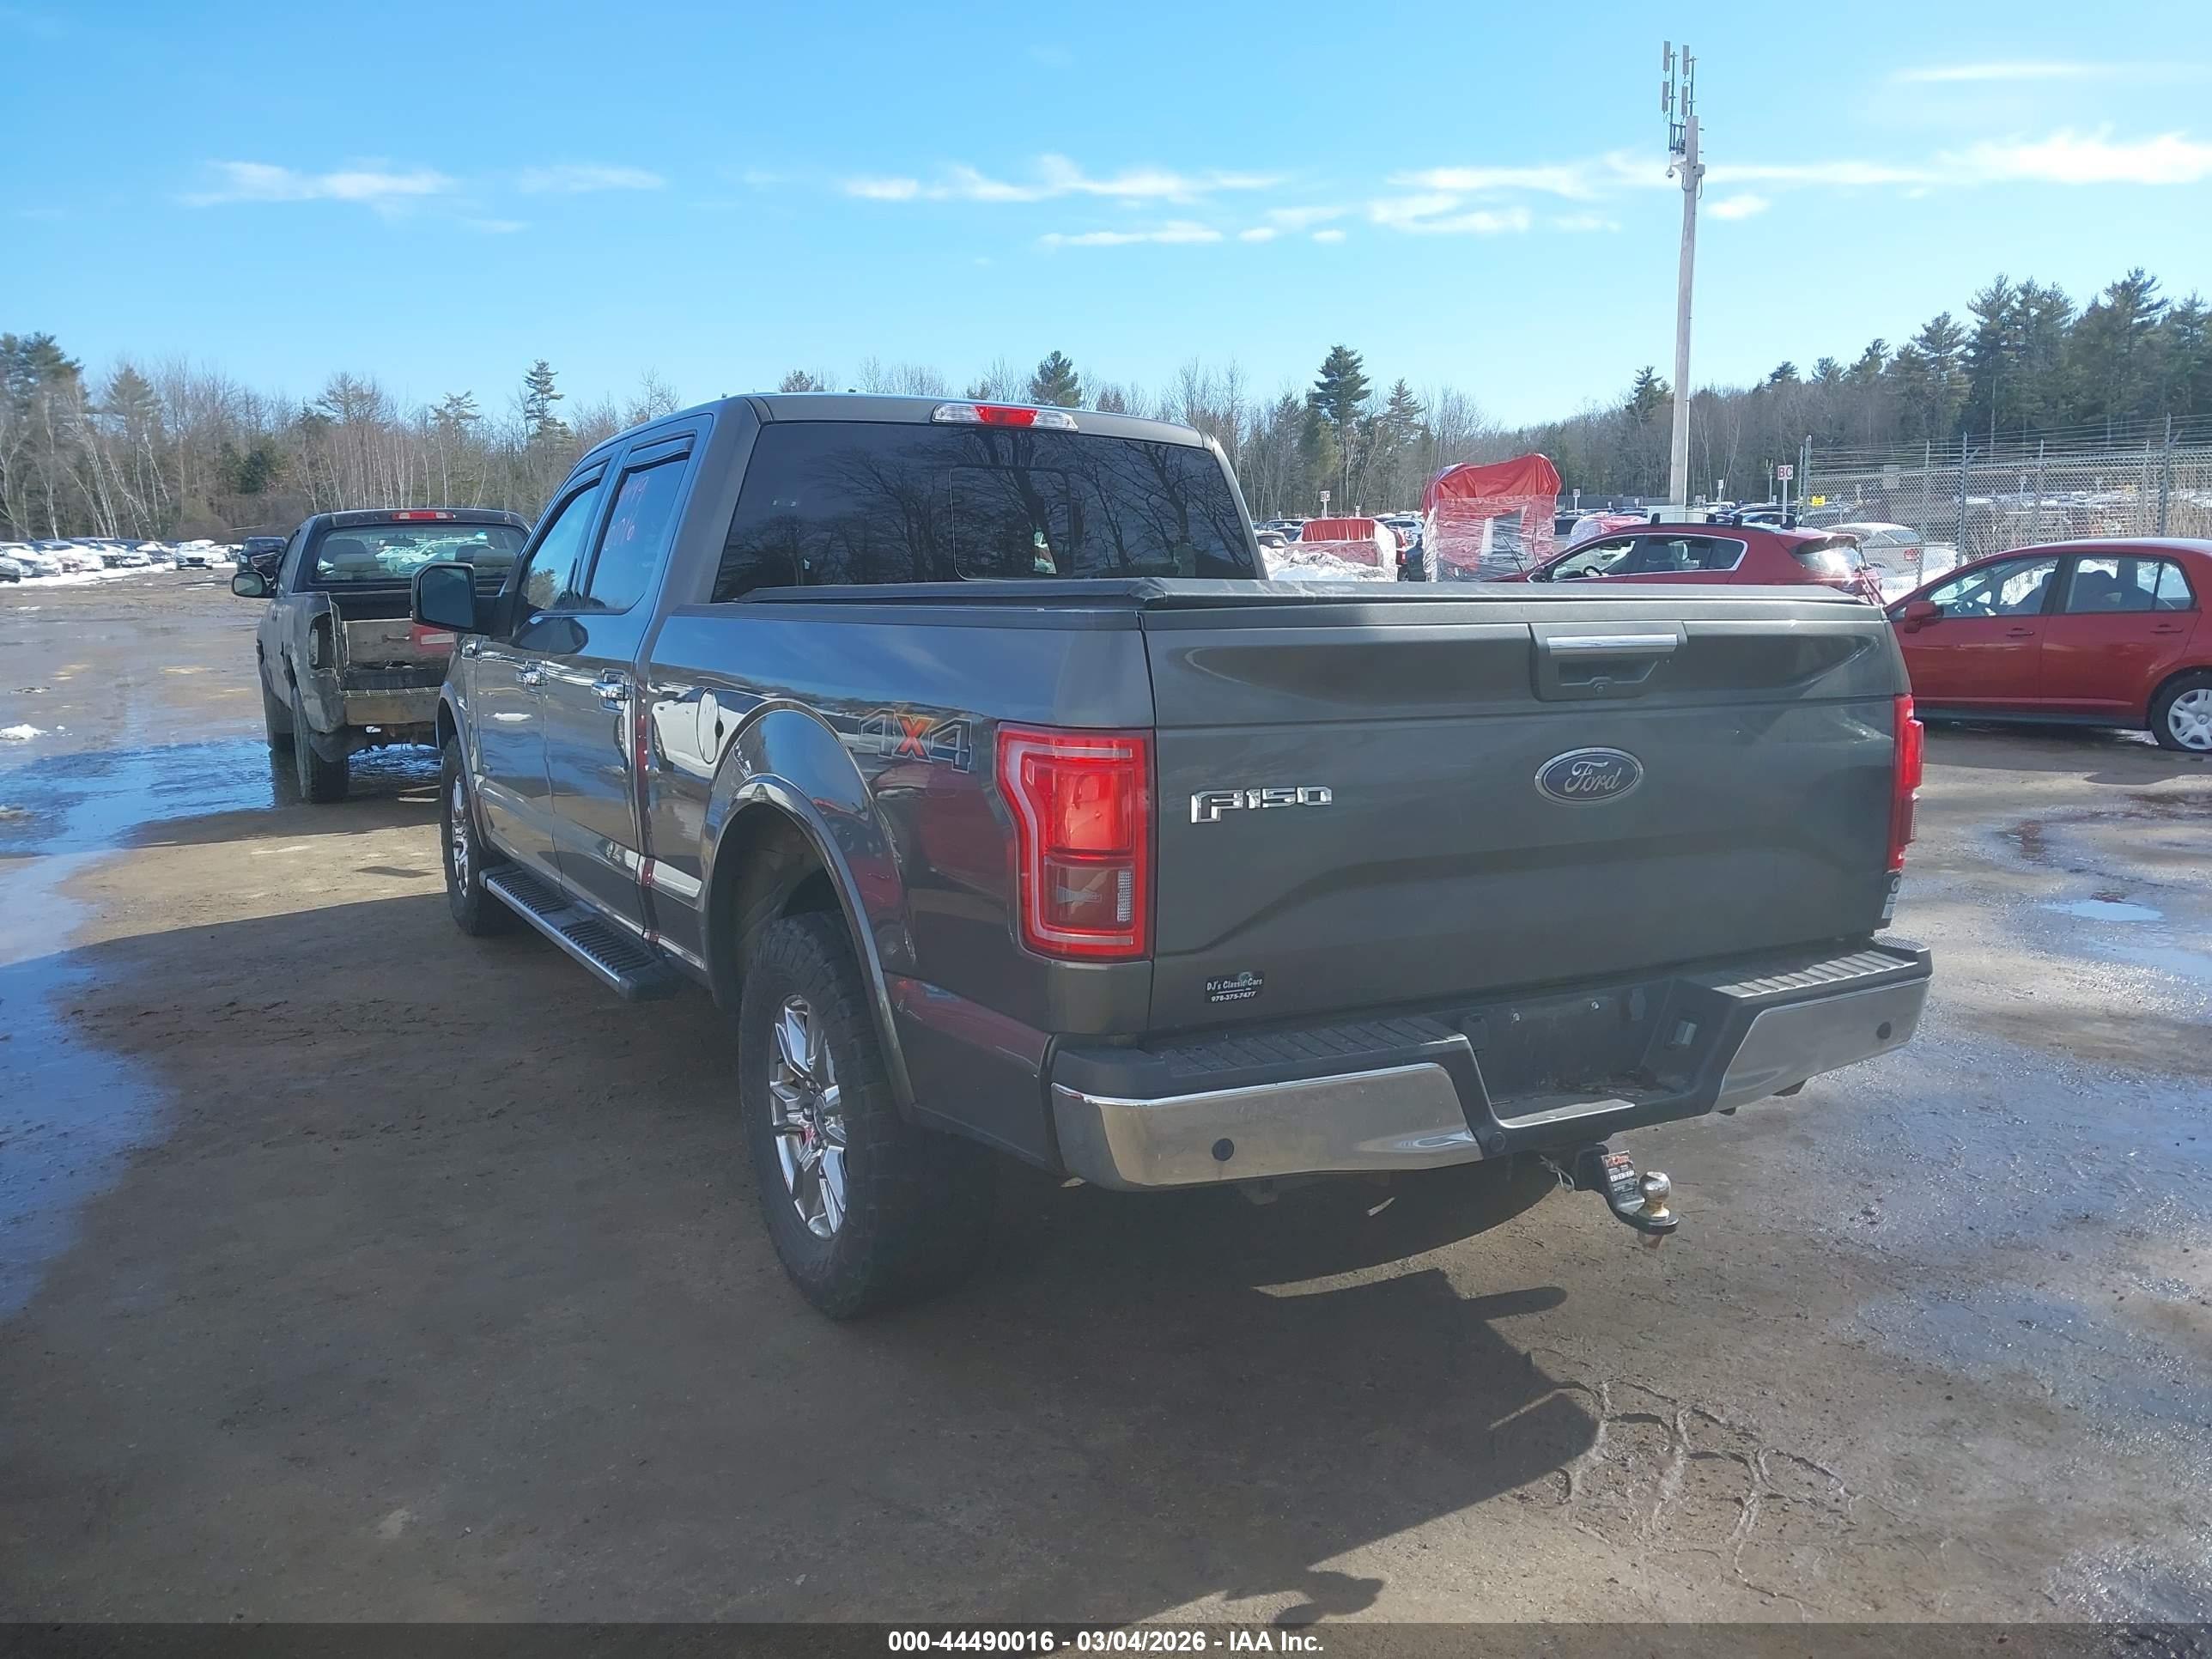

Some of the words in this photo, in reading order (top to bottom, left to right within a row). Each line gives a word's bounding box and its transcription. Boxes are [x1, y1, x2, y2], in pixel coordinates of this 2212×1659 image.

[1778, 467, 1793, 477] BC
[1565, 761, 1621, 793] Ford
[1206, 981, 1222, 991] DJ's
[1223, 980, 1248, 989] Classic
[1248, 977, 1263, 986] Cars
